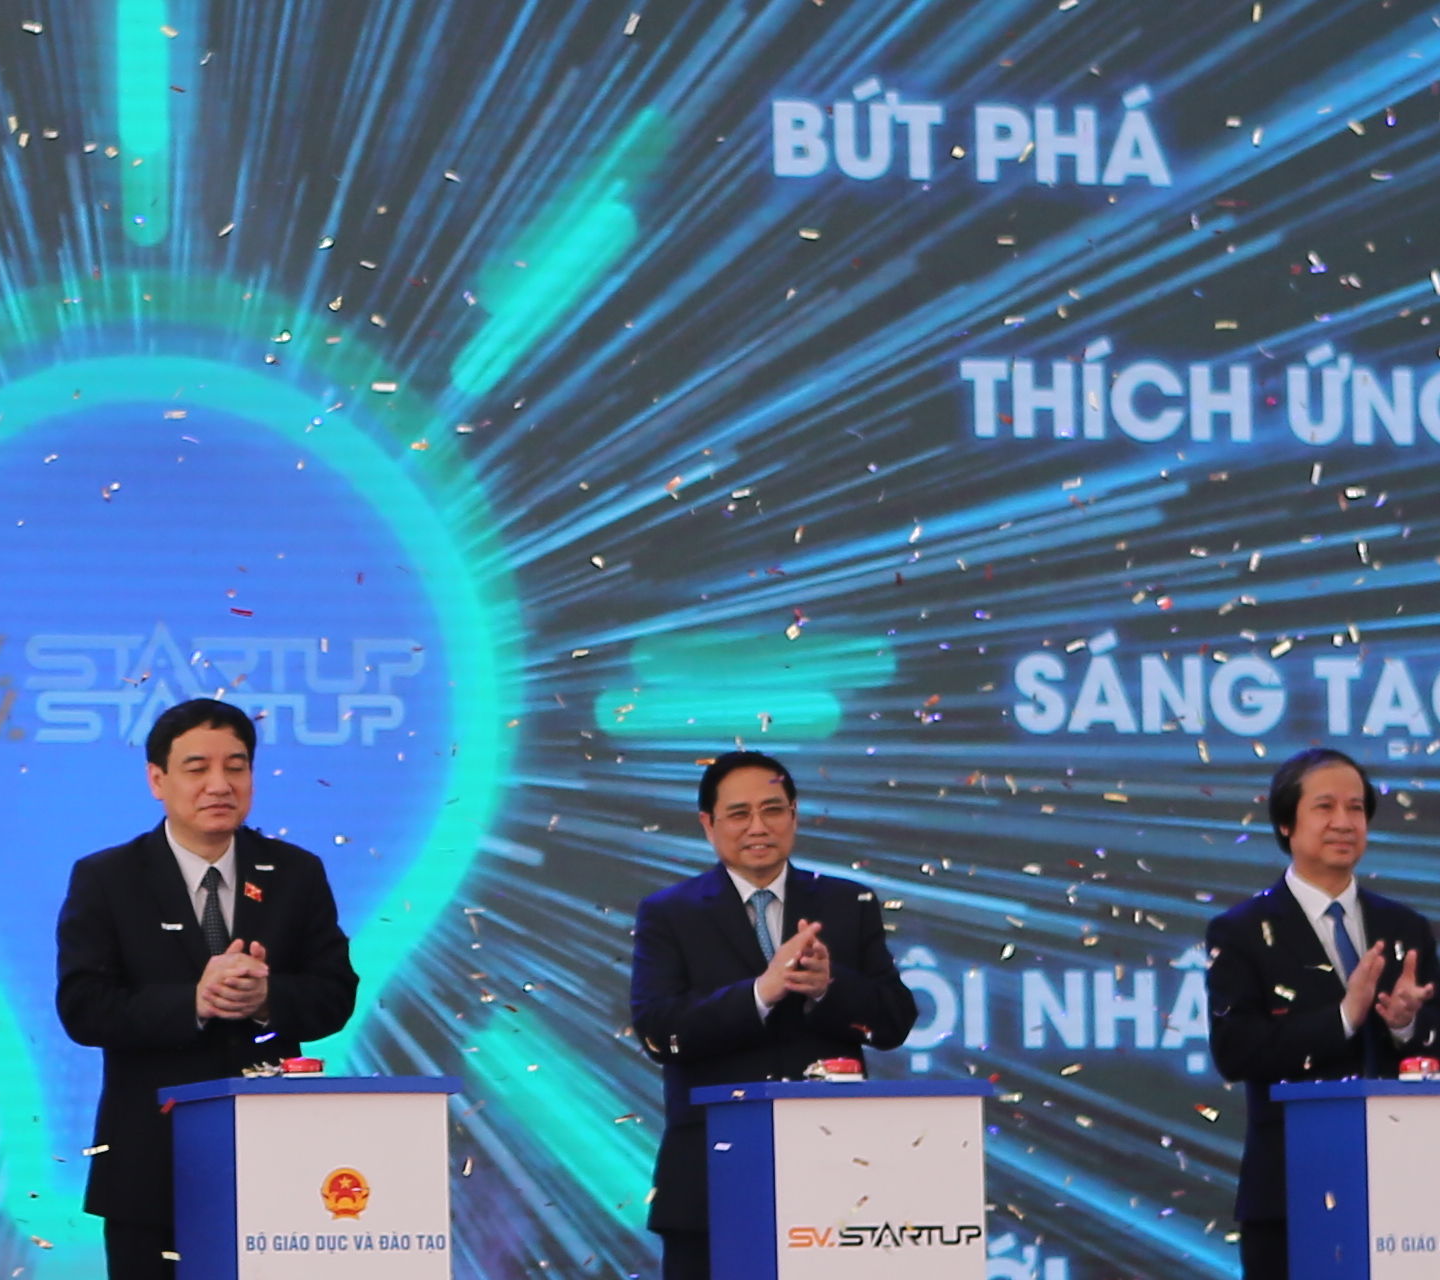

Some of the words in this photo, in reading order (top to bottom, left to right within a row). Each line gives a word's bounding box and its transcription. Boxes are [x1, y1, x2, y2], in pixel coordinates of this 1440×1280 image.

[772, 77, 944, 181] BỨT
[975, 83, 1172, 187] PHÁ
[960, 337, 1254, 443] THÍCH
[1014, 629, 1287, 737] SÁNG
[899, 945, 989, 1072] ỘI
[1022, 945, 1209, 1075] NHẬ
[245, 1231, 267, 1255] BỘ
[273, 1231, 310, 1252] GIÁO
[316, 1234, 348, 1255] DỤC
[354, 1231, 374, 1252] VÀ
[379, 1231, 411, 1252] ĐÀO
[416, 1234, 446, 1255] TẠO
[1376, 1233, 1396, 1255] BỘ
